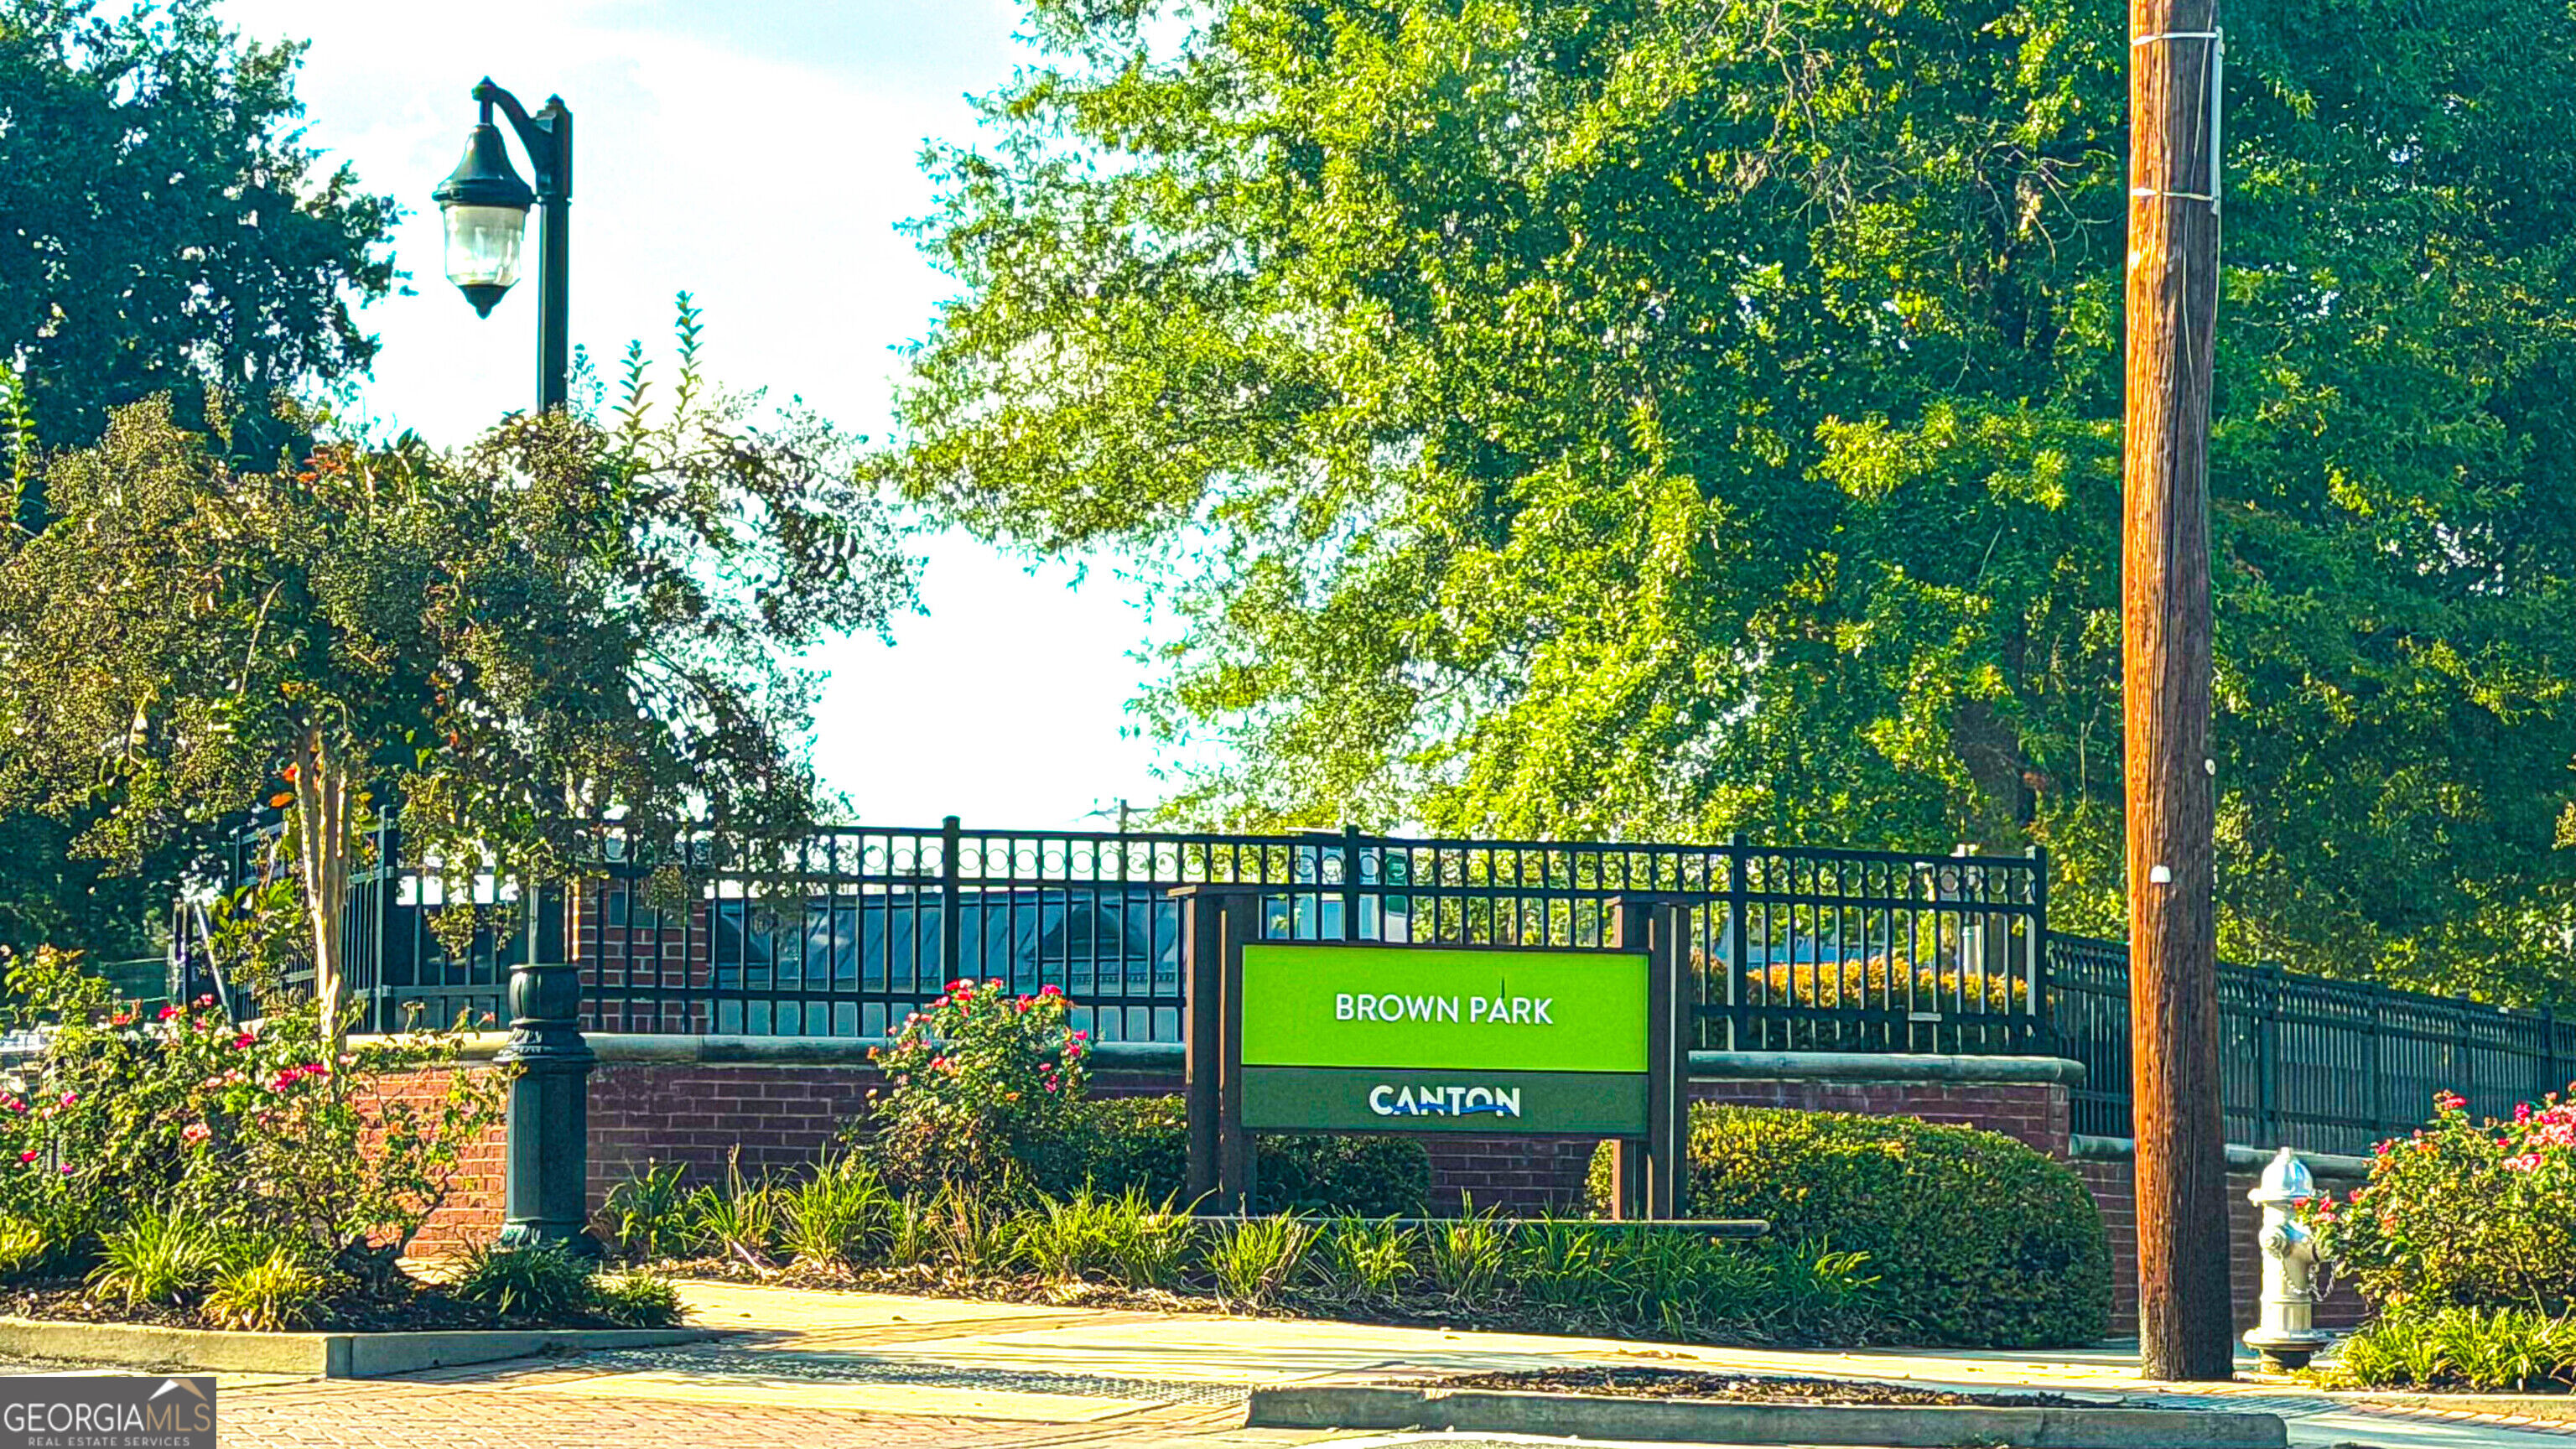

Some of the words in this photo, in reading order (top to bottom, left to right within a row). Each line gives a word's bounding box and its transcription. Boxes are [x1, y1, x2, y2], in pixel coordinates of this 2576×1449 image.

[1336, 993, 1459, 1024] BROWN
[1470, 996, 1554, 1025] PARK
[1369, 1085, 1520, 1118] CANTON
